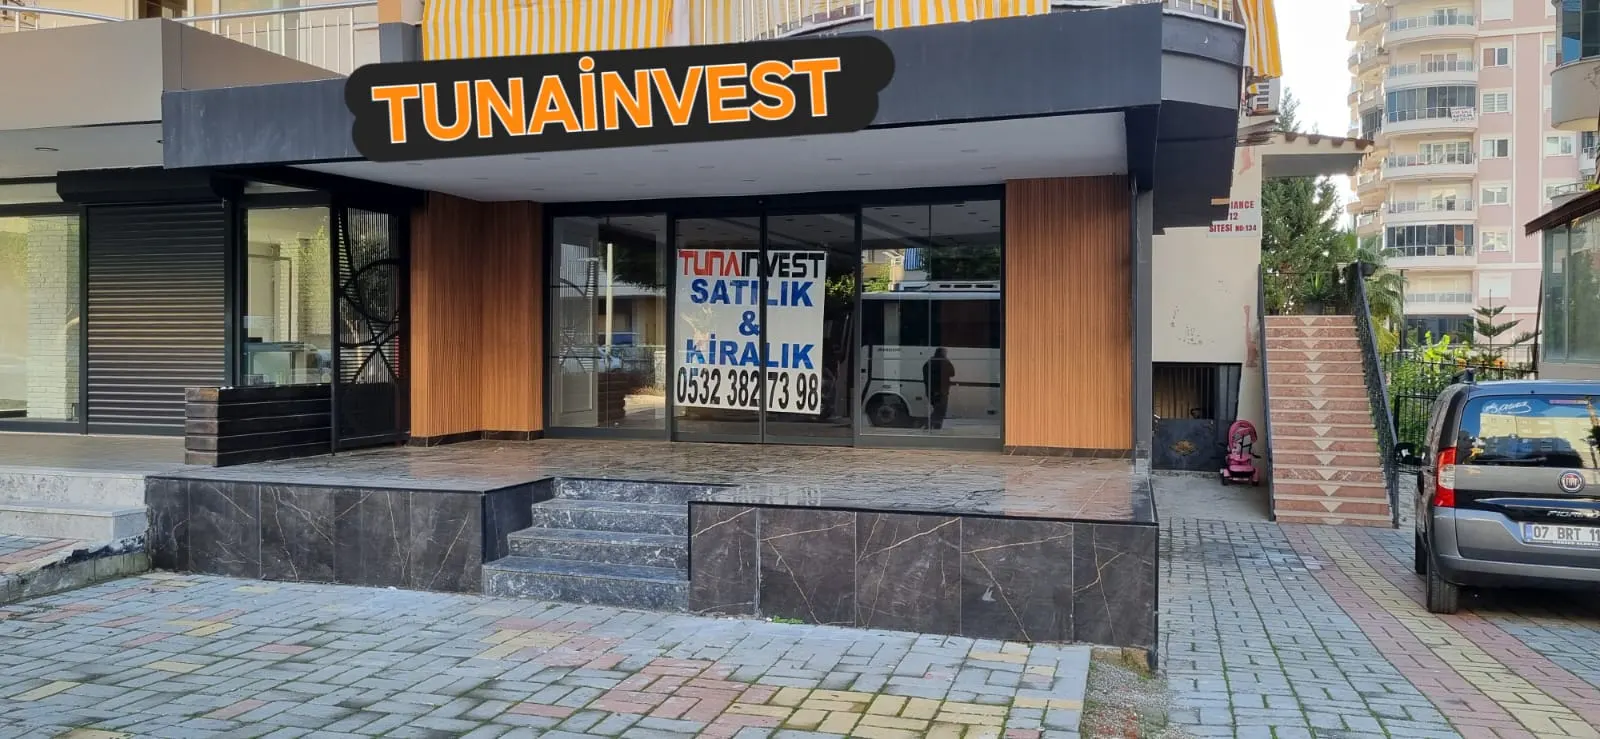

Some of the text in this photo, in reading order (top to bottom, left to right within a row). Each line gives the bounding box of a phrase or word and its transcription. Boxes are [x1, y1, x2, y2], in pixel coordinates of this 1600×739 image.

[690, 278, 814, 307] SATILIK
[738, 310, 760, 336] &
[677, 366, 819, 411] 0532 382 73 98
[1534, 525, 1549, 539] 07
[1557, 527, 1581, 541] BRT
